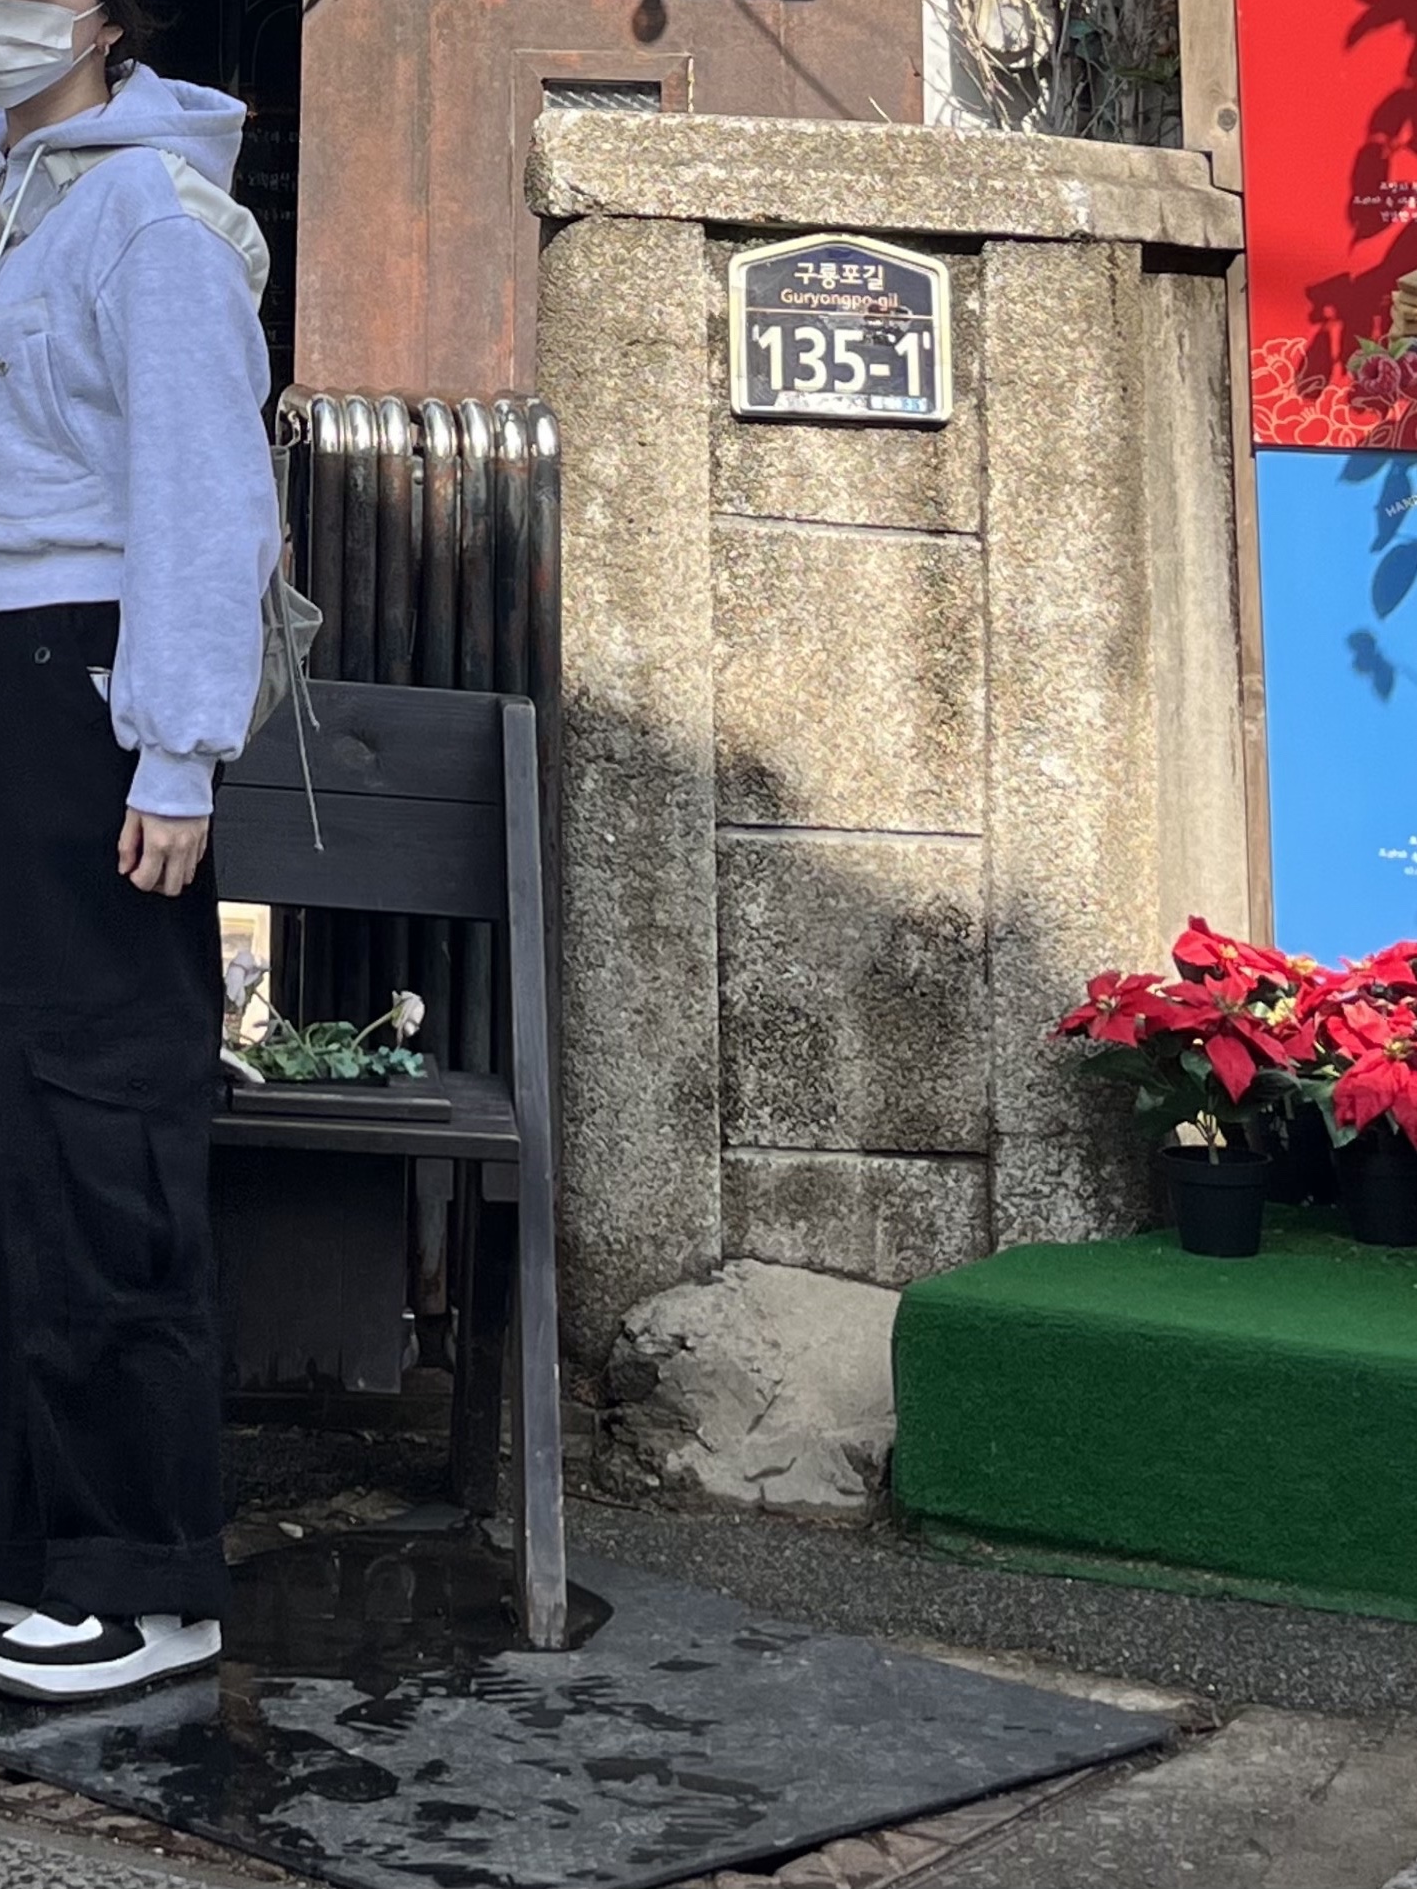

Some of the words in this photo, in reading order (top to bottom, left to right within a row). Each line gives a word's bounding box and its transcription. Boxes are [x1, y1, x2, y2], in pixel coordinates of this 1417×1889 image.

[794, 262, 885, 291] 구룡포길
[780, 288, 899, 310] Guryongpo-gil
[757, 325, 921, 397] 135-1
